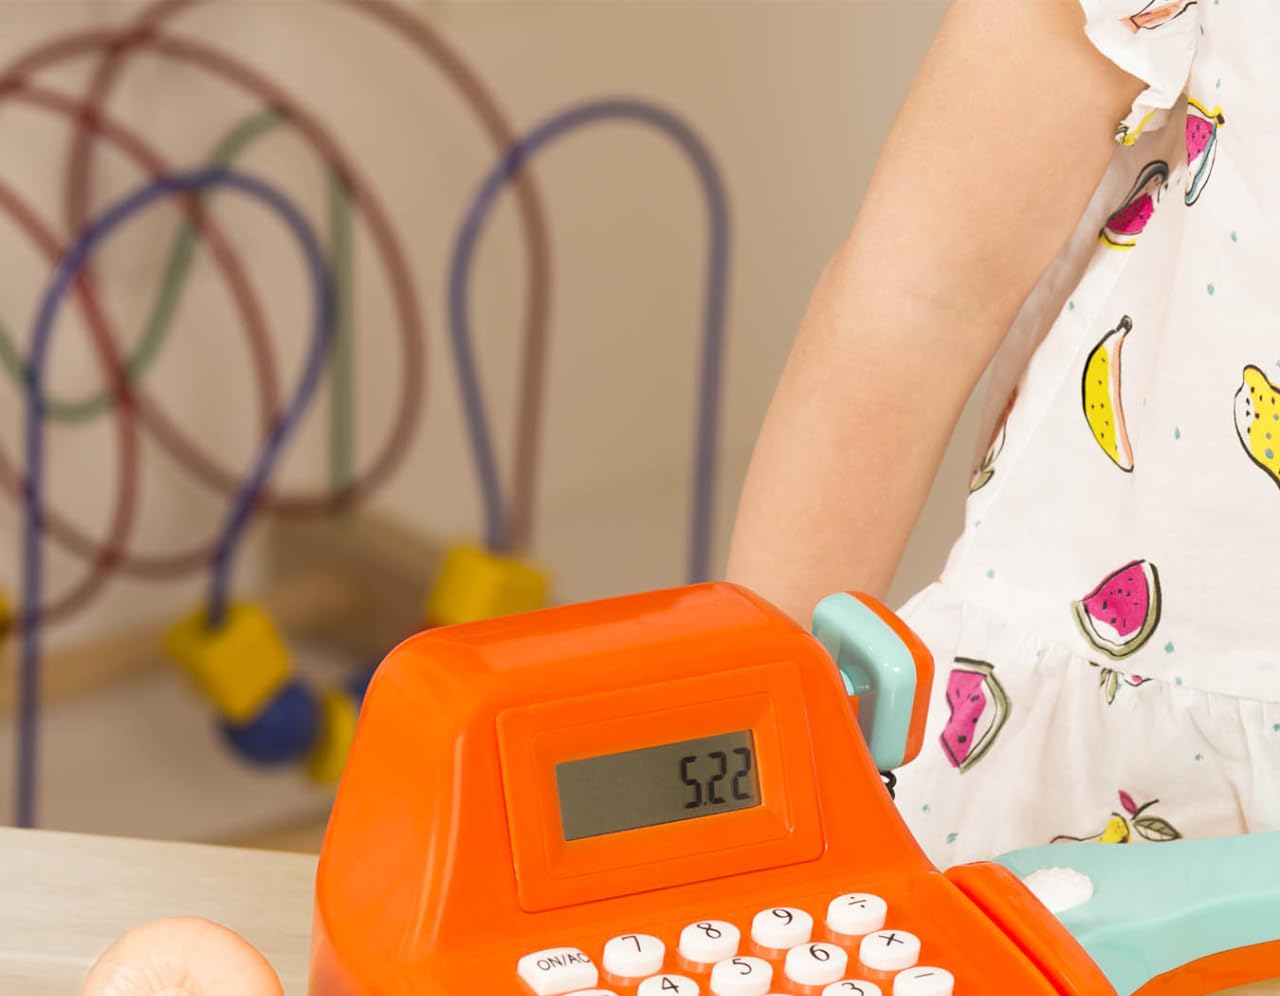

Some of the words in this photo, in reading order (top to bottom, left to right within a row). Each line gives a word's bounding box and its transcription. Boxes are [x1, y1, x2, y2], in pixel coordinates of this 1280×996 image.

[680, 747, 752, 809] 5.22
[772, 908, 794, 926] 9
[696, 921, 722, 940] 8
[621, 935, 642, 953] 7
[809, 944, 831, 962] 6
[536, 951, 592, 972] ON/AC
[732, 957, 753, 976] 5
[661, 976, 680, 994] 4
